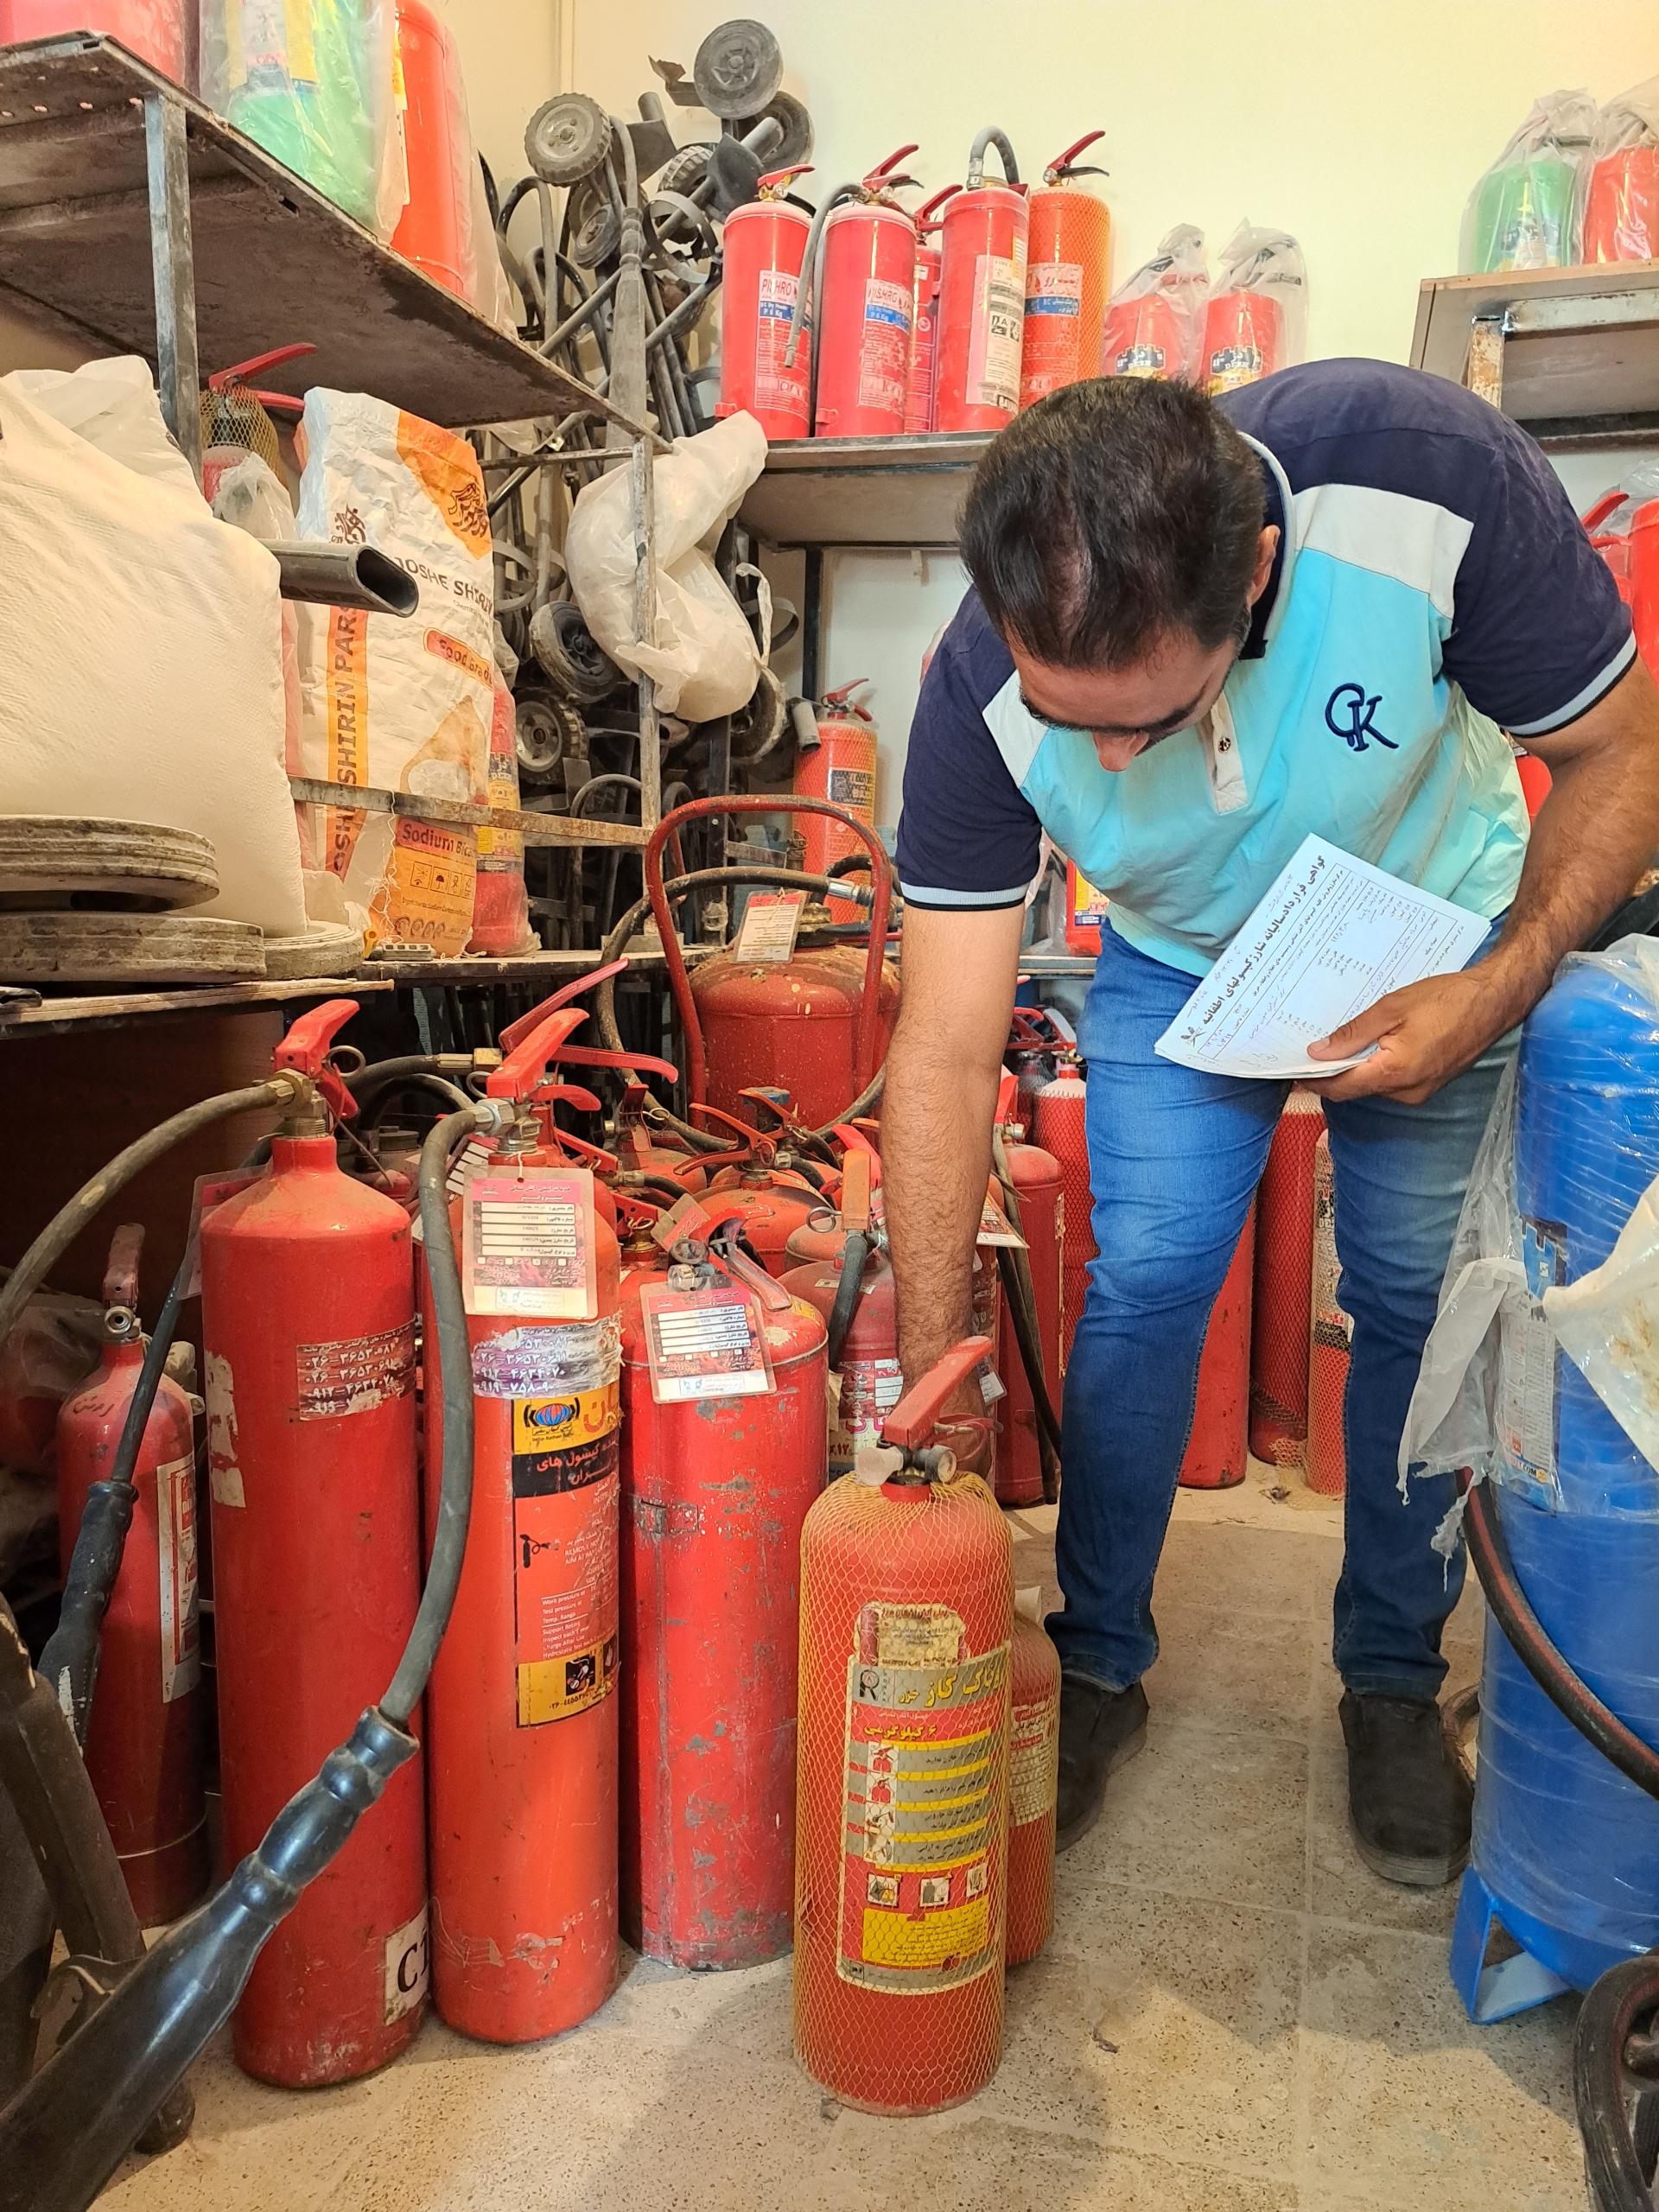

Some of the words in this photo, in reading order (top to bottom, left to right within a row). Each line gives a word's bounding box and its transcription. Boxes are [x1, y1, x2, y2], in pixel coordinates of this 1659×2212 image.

[337, 681, 357, 785] SHIRIN
[403, 823, 454, 852] Sodium
[1304, 855, 1328, 885] گواهی
[537, 1456, 562, 1471] های
[555, 1603, 577, 1615] pressure
[558, 1592, 581, 1604] pressure
[924, 1672, 958, 1707] گاز
